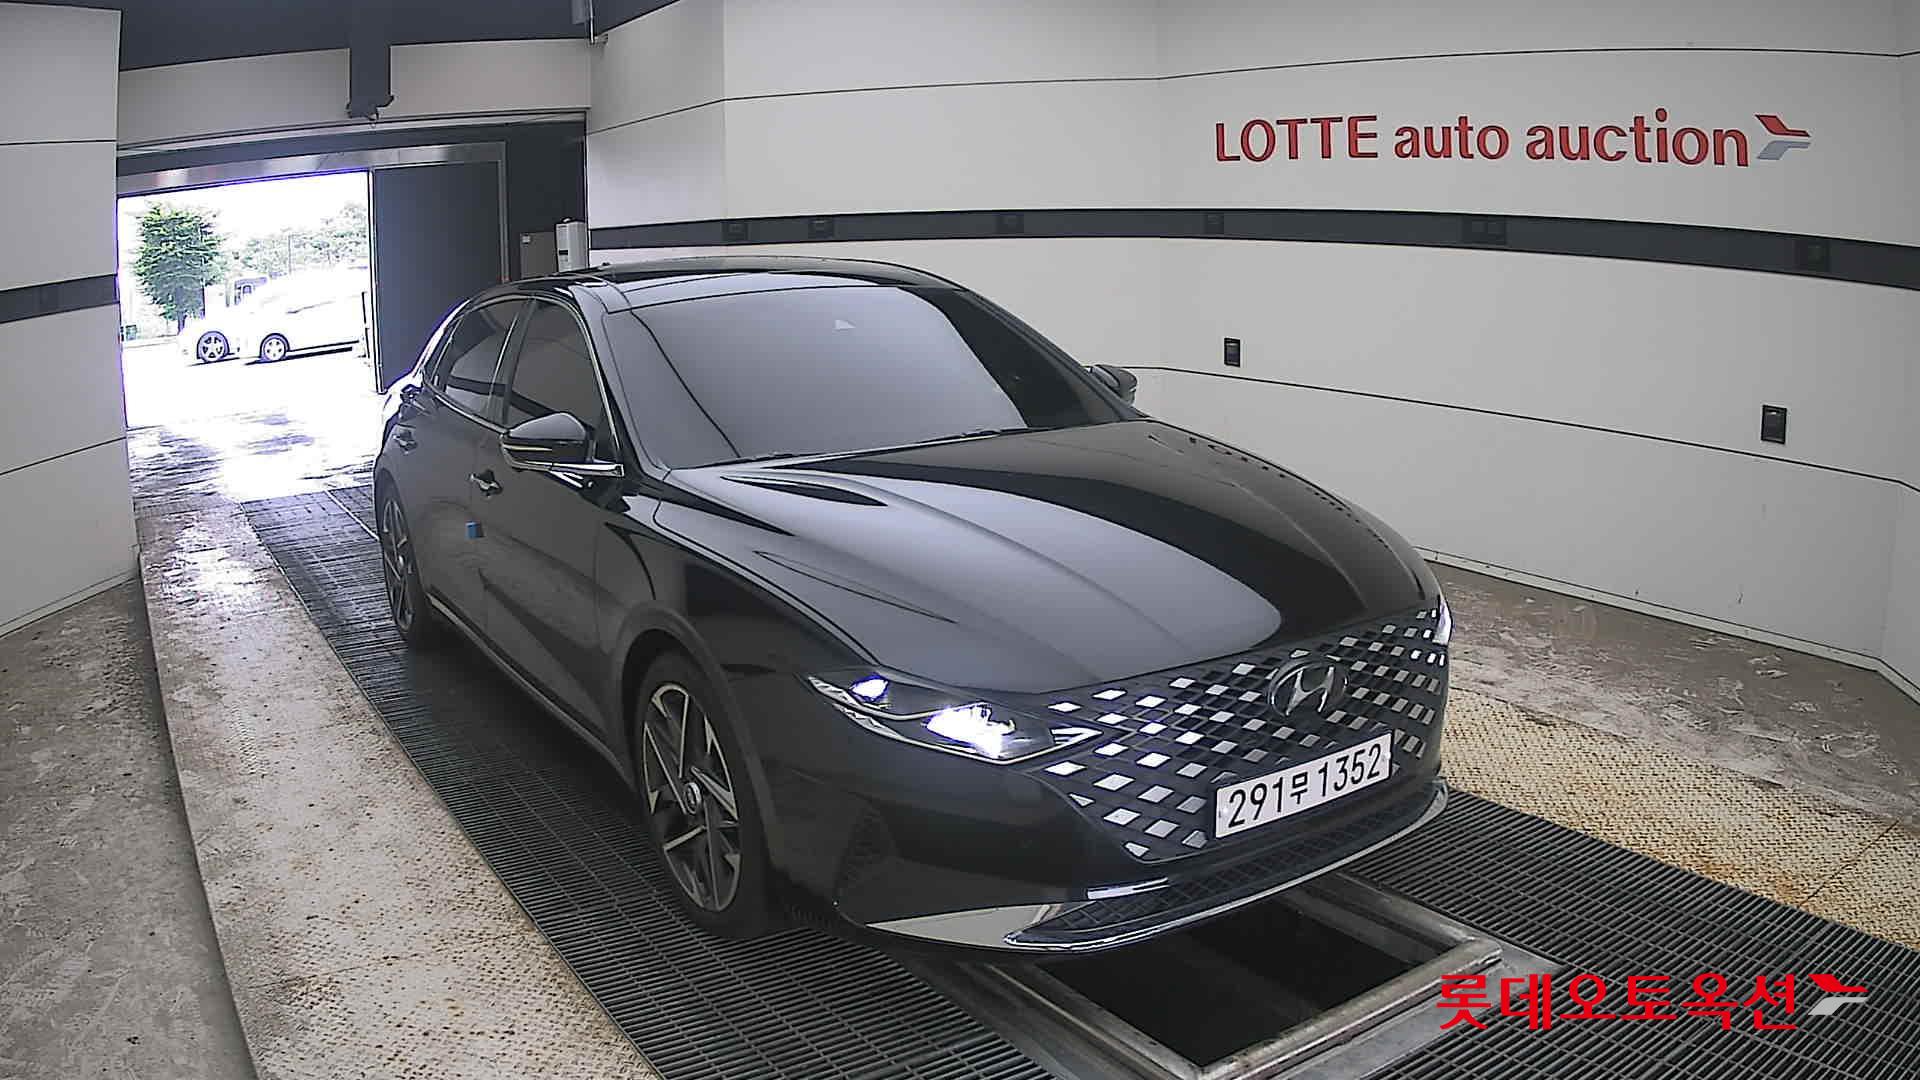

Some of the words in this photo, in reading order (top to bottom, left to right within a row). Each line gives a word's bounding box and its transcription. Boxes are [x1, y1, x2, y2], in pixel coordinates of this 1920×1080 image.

[1215, 115, 1378, 162] LOTTE
[1393, 115, 1511, 160] auto
[1526, 108, 1750, 167] auction
